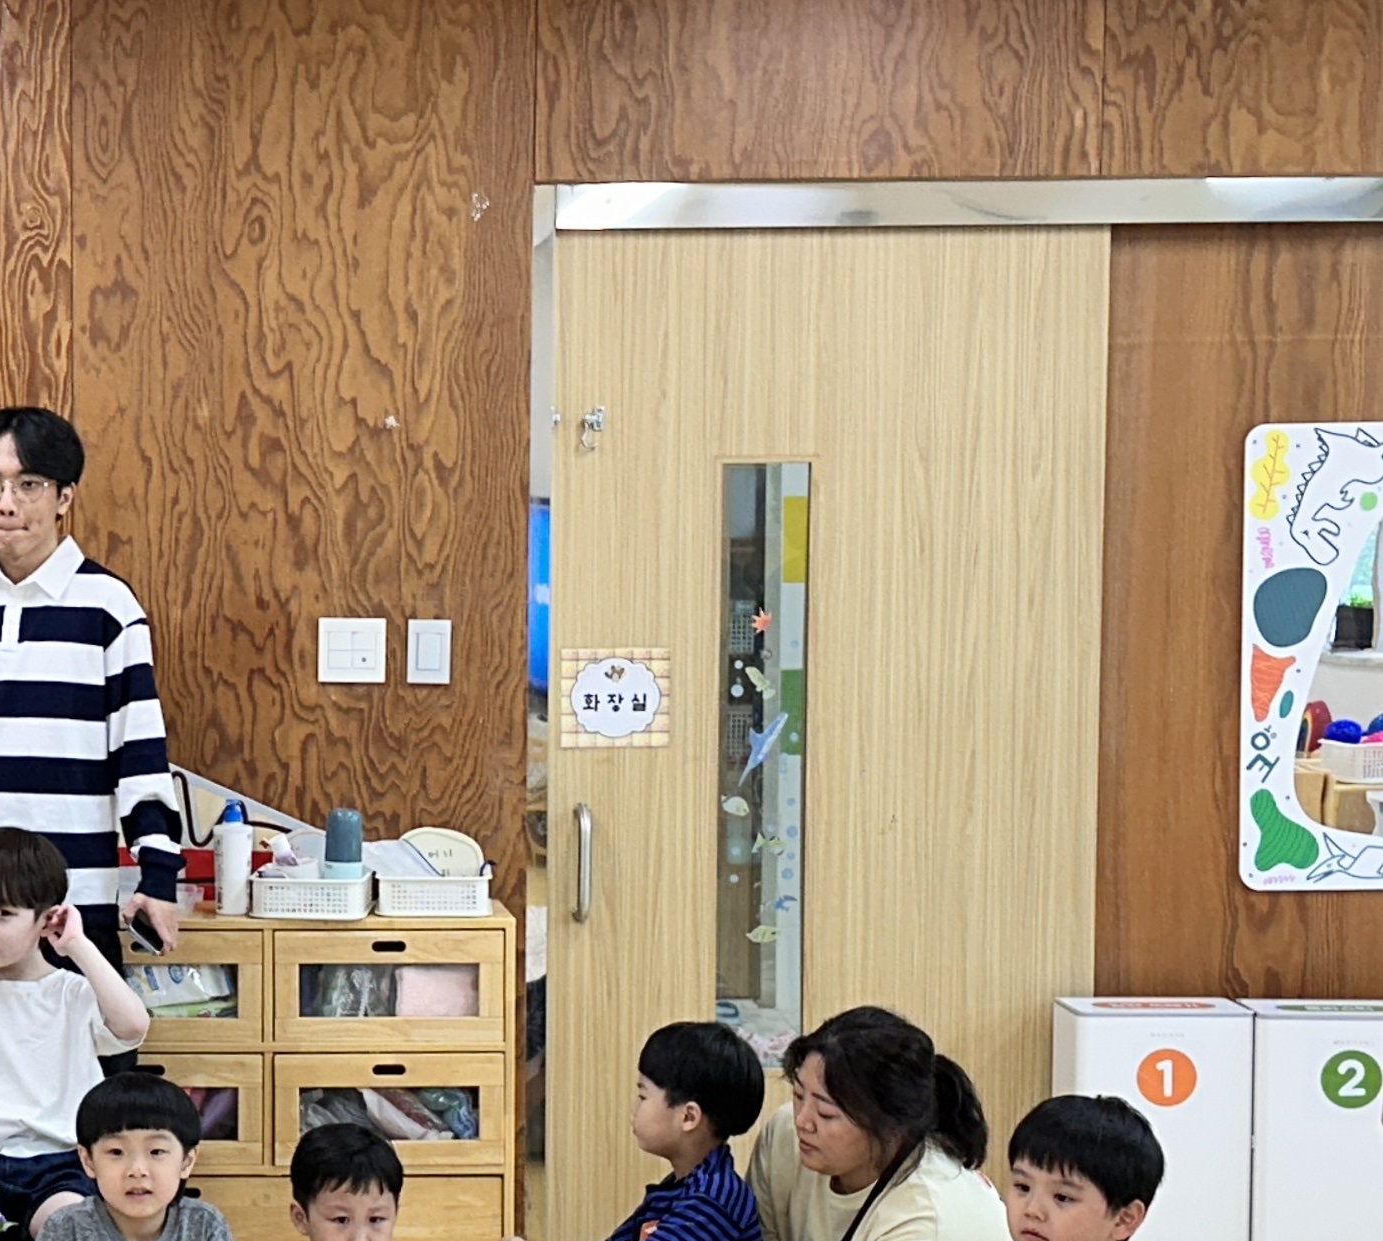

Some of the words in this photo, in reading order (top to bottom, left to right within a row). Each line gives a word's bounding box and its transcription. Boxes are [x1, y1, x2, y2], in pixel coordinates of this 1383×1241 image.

[582, 693, 648, 713] 화장실
[1155, 1058, 1174, 1098] 1
[1336, 1058, 1367, 1098] 2
